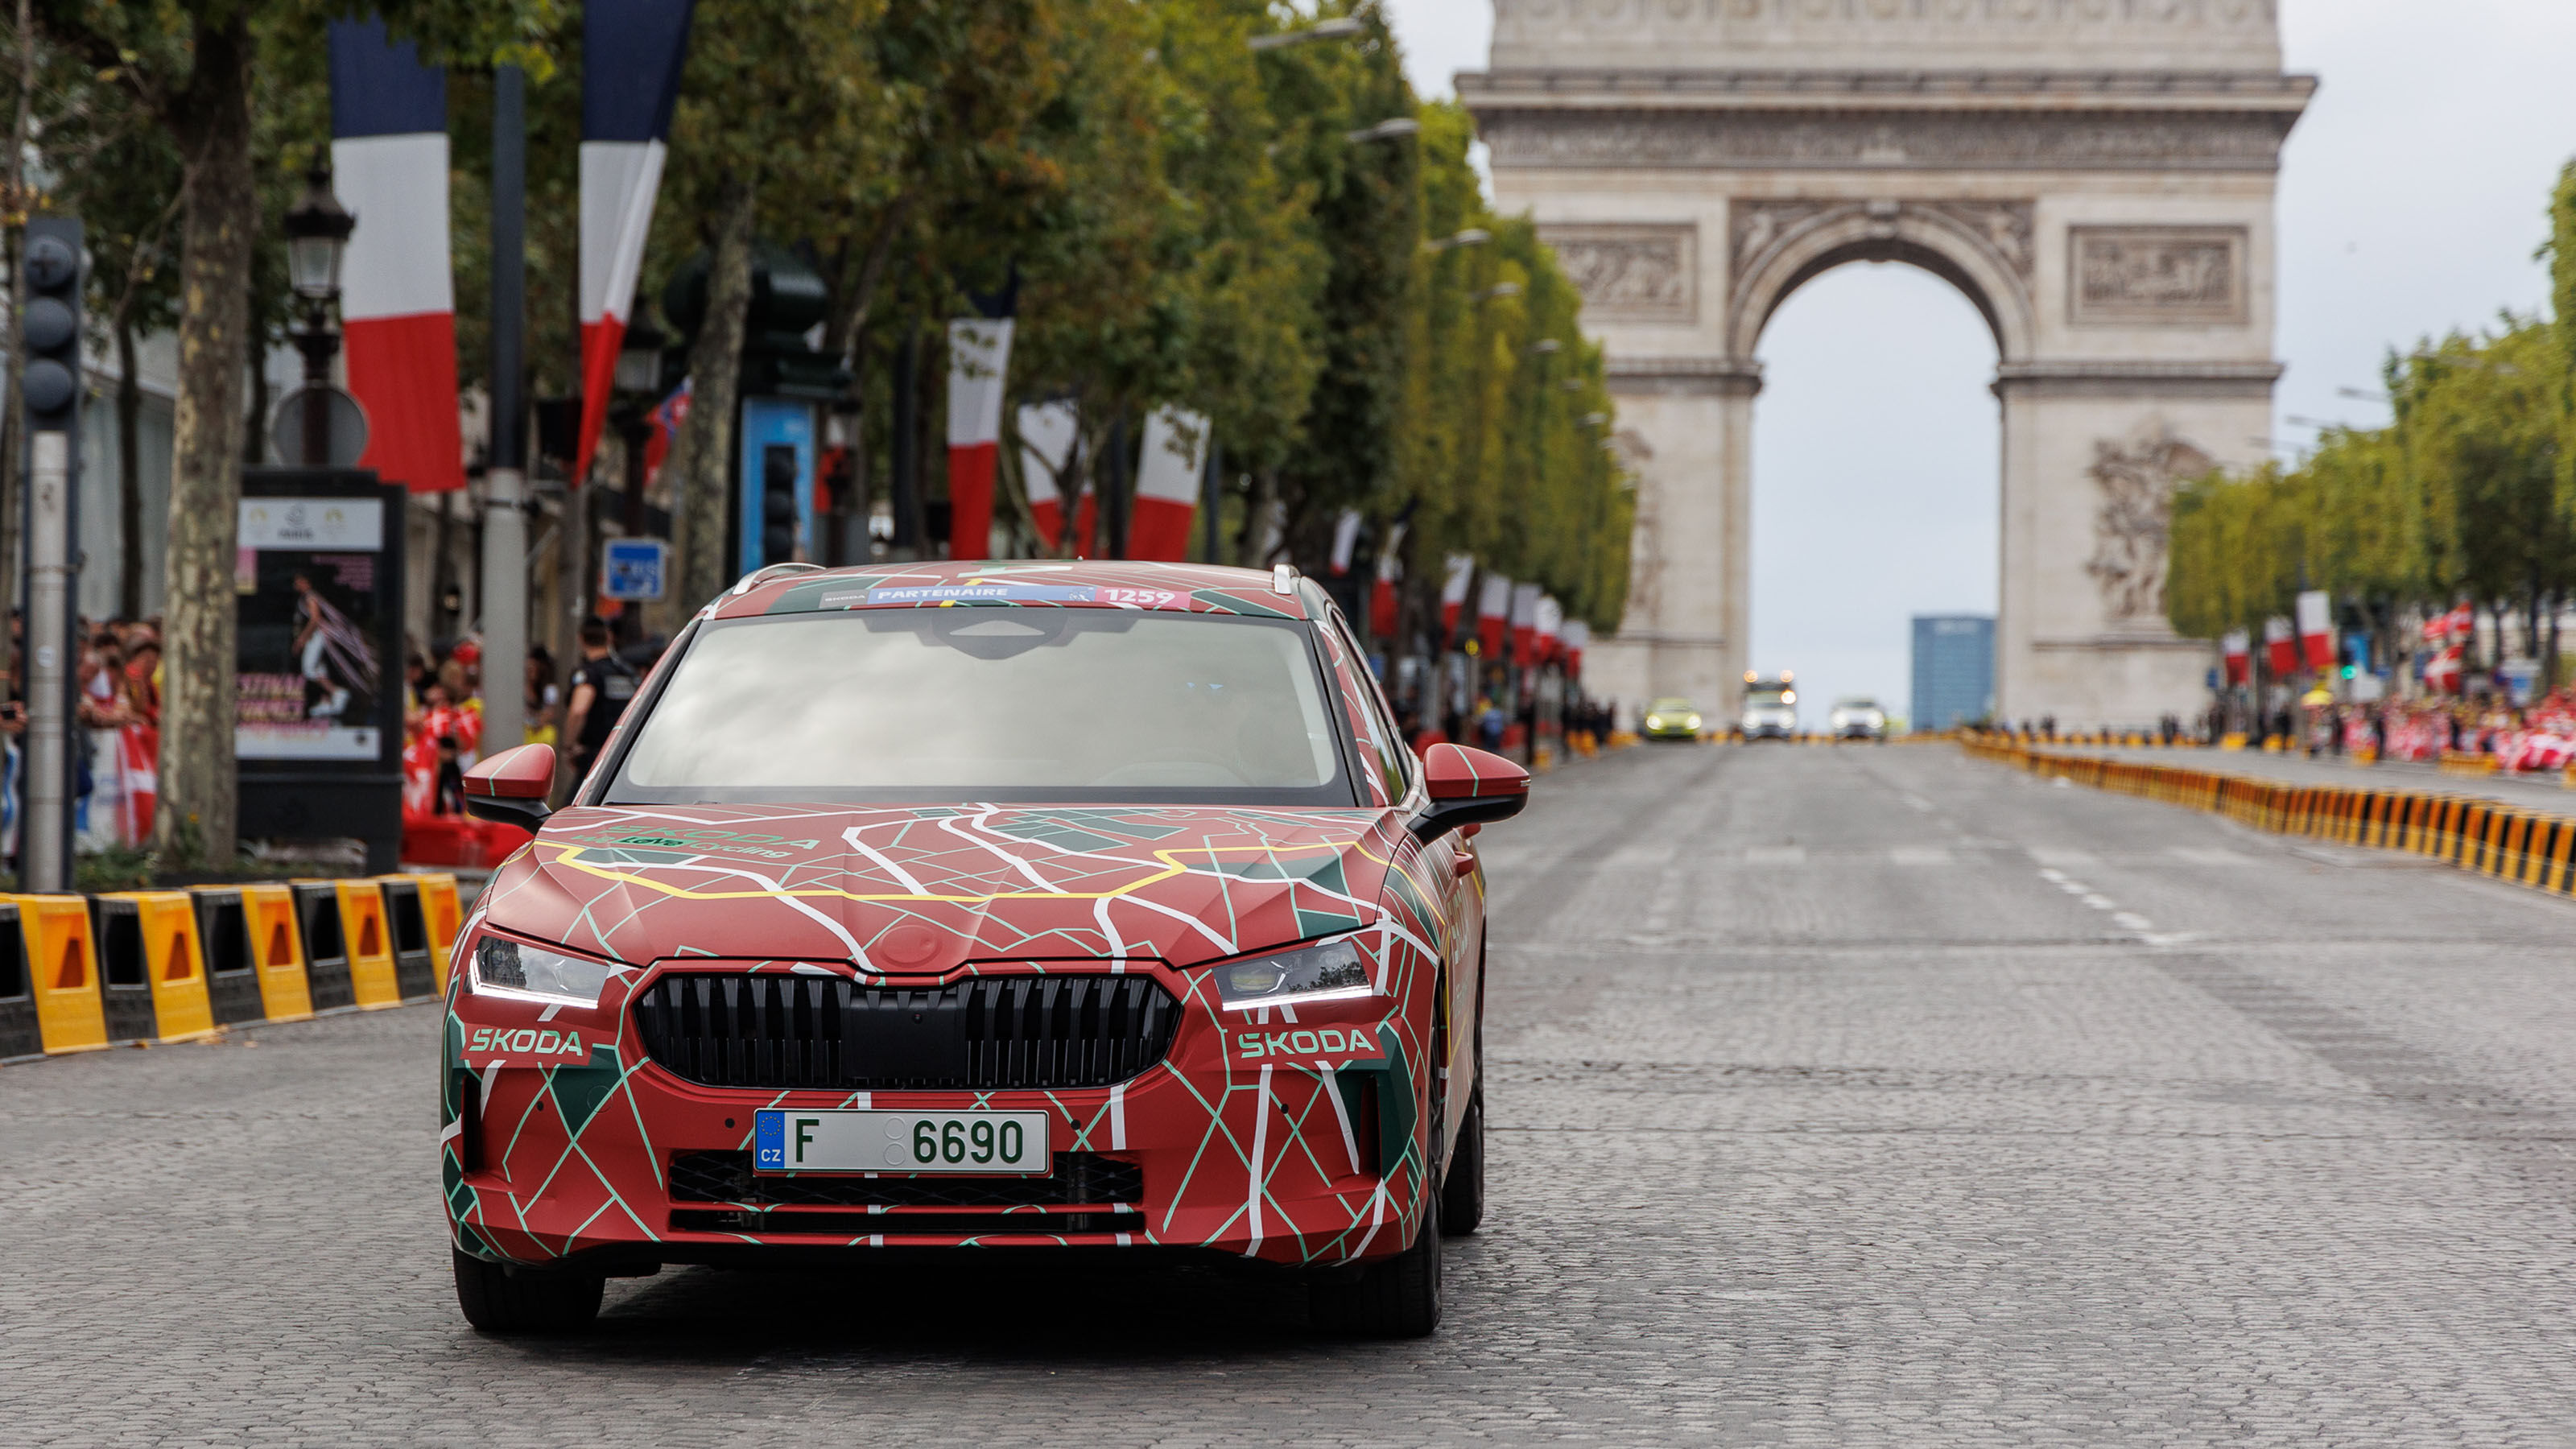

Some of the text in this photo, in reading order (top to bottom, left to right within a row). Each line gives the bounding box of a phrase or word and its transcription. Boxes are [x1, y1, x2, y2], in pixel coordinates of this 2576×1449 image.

[877, 588, 1008, 600] PARTENAIRE
[1104, 588, 1176, 605] 1259
[617, 836, 684, 848] Love
[689, 841, 794, 859] Cycling
[795, 1118, 1023, 1165] F 6690
[761, 1149, 782, 1162] CZ
